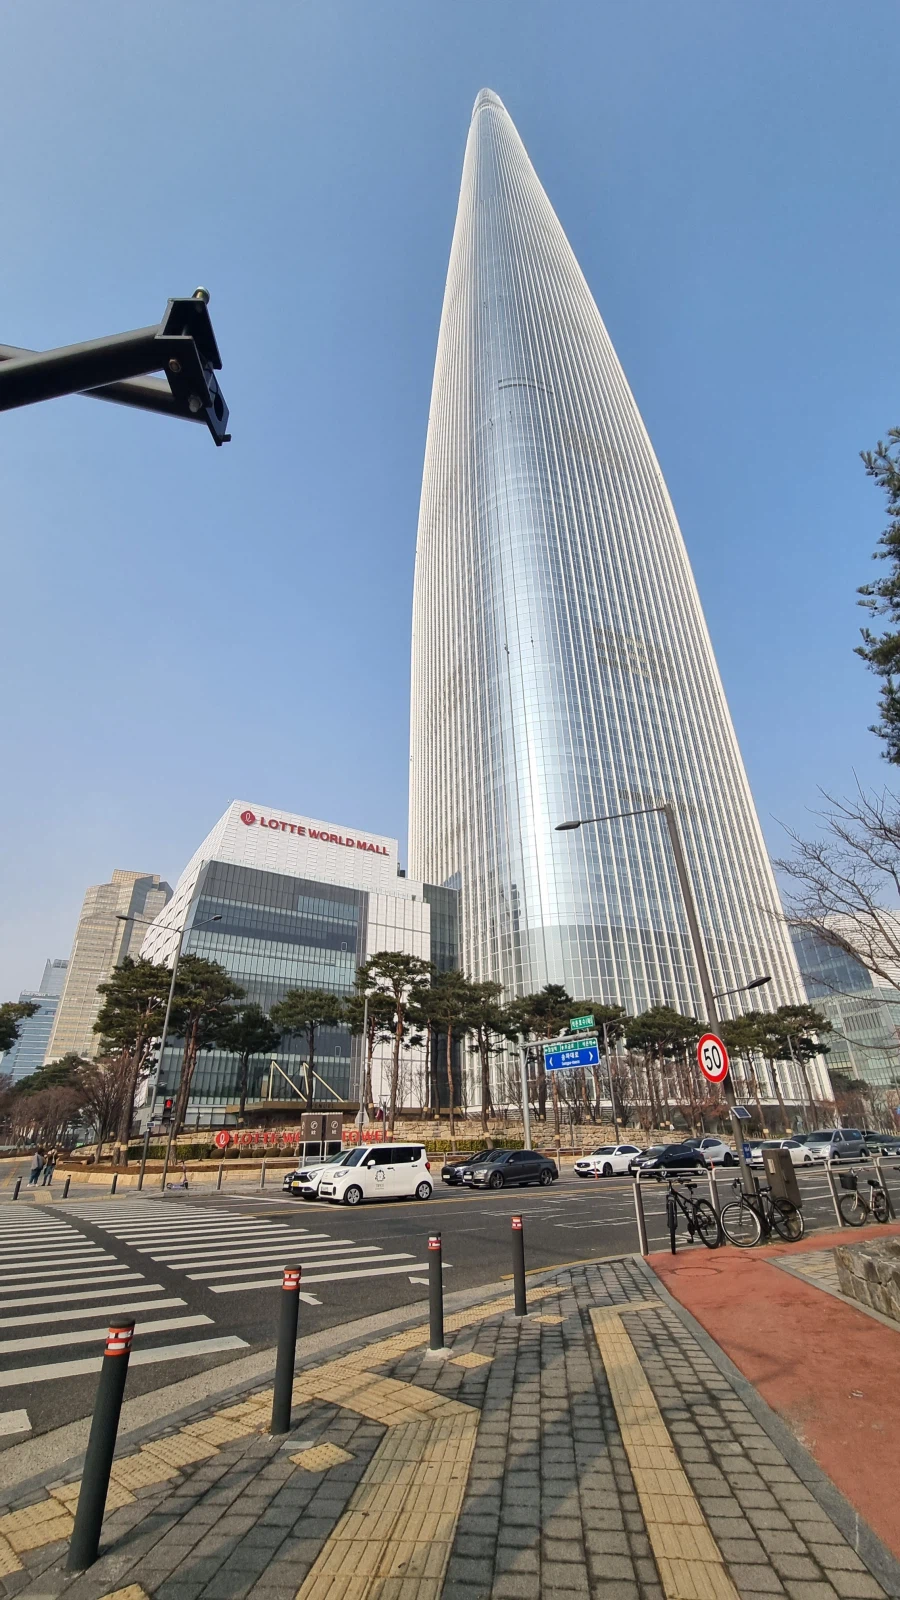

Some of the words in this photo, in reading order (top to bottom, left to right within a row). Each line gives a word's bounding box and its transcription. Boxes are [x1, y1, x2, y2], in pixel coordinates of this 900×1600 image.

[260, 816, 307, 836] LOTTE
[308, 828, 355, 847] WORLD
[356, 840, 390, 856] MALL
[561, 1051, 580, 1061] 송파대로
[703, 1045, 721, 1071] 50
